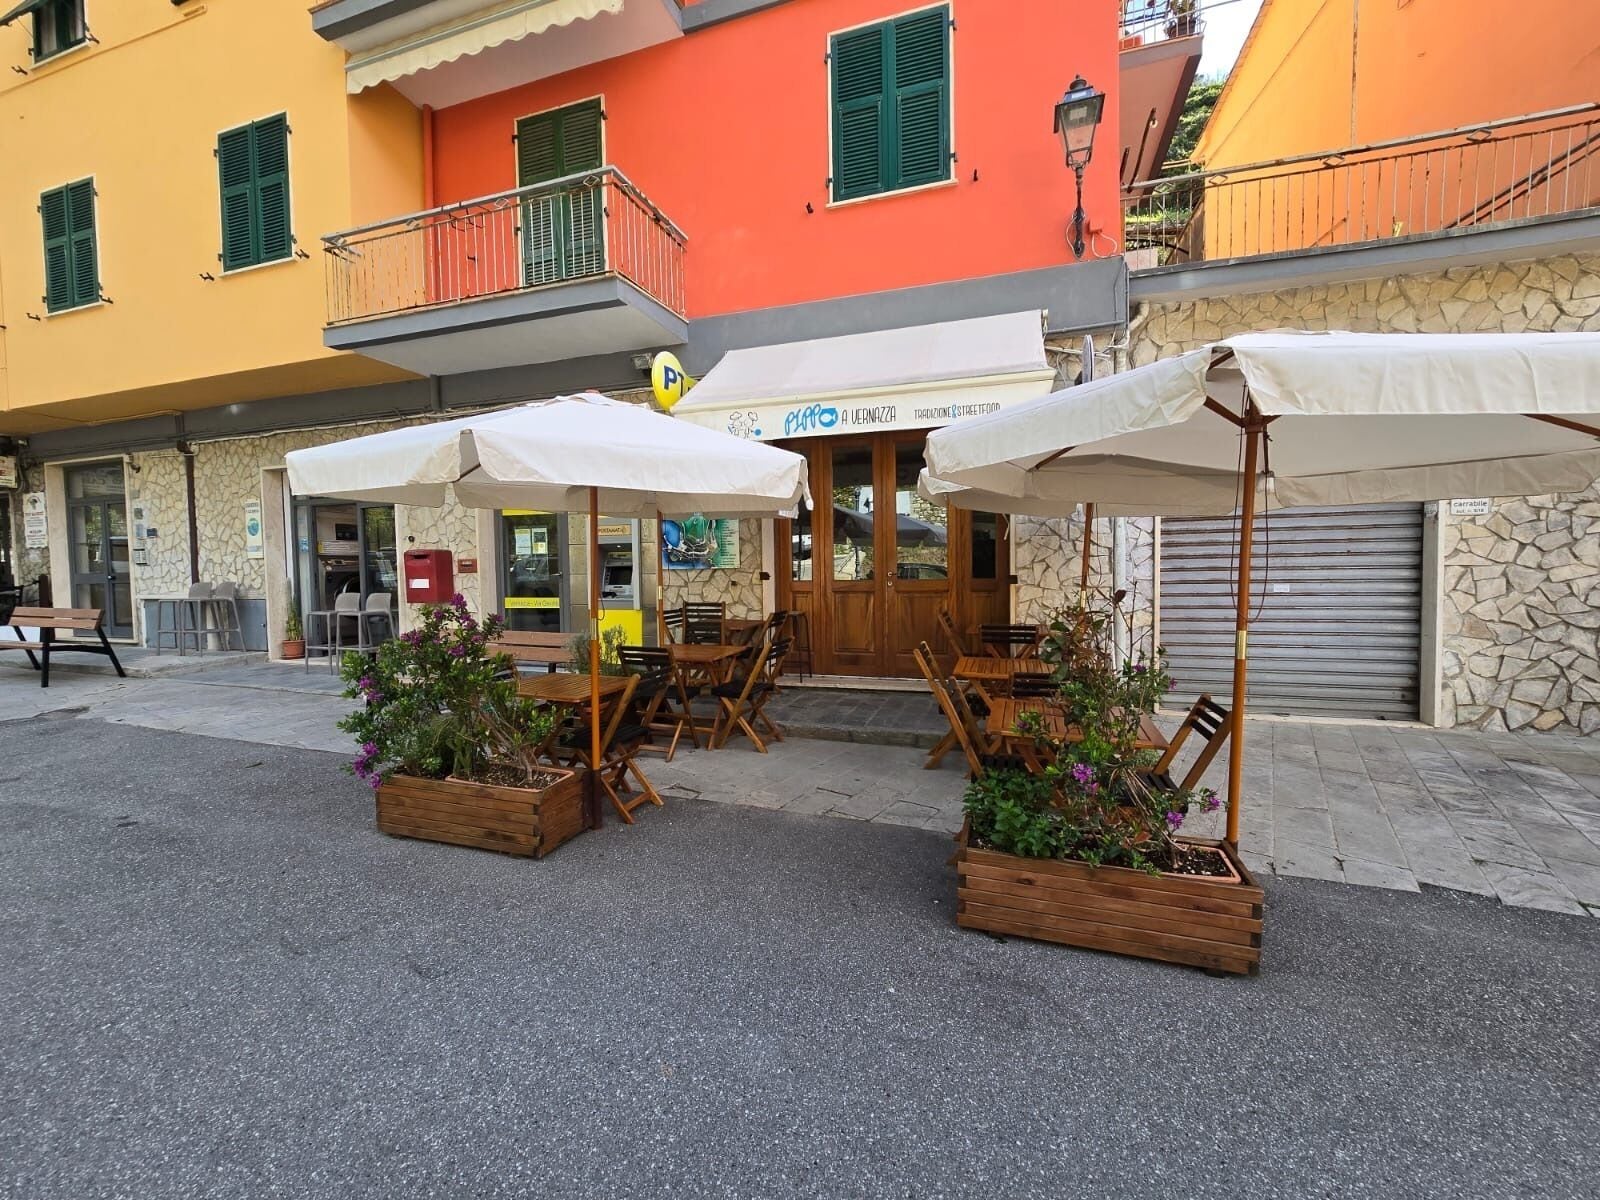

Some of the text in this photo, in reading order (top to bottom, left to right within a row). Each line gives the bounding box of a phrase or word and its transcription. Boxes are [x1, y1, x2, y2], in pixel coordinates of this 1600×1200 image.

[664, 365, 684, 397] PT
[841, 409, 848, 424] A
[852, 405, 896, 425] VERNAZZA
